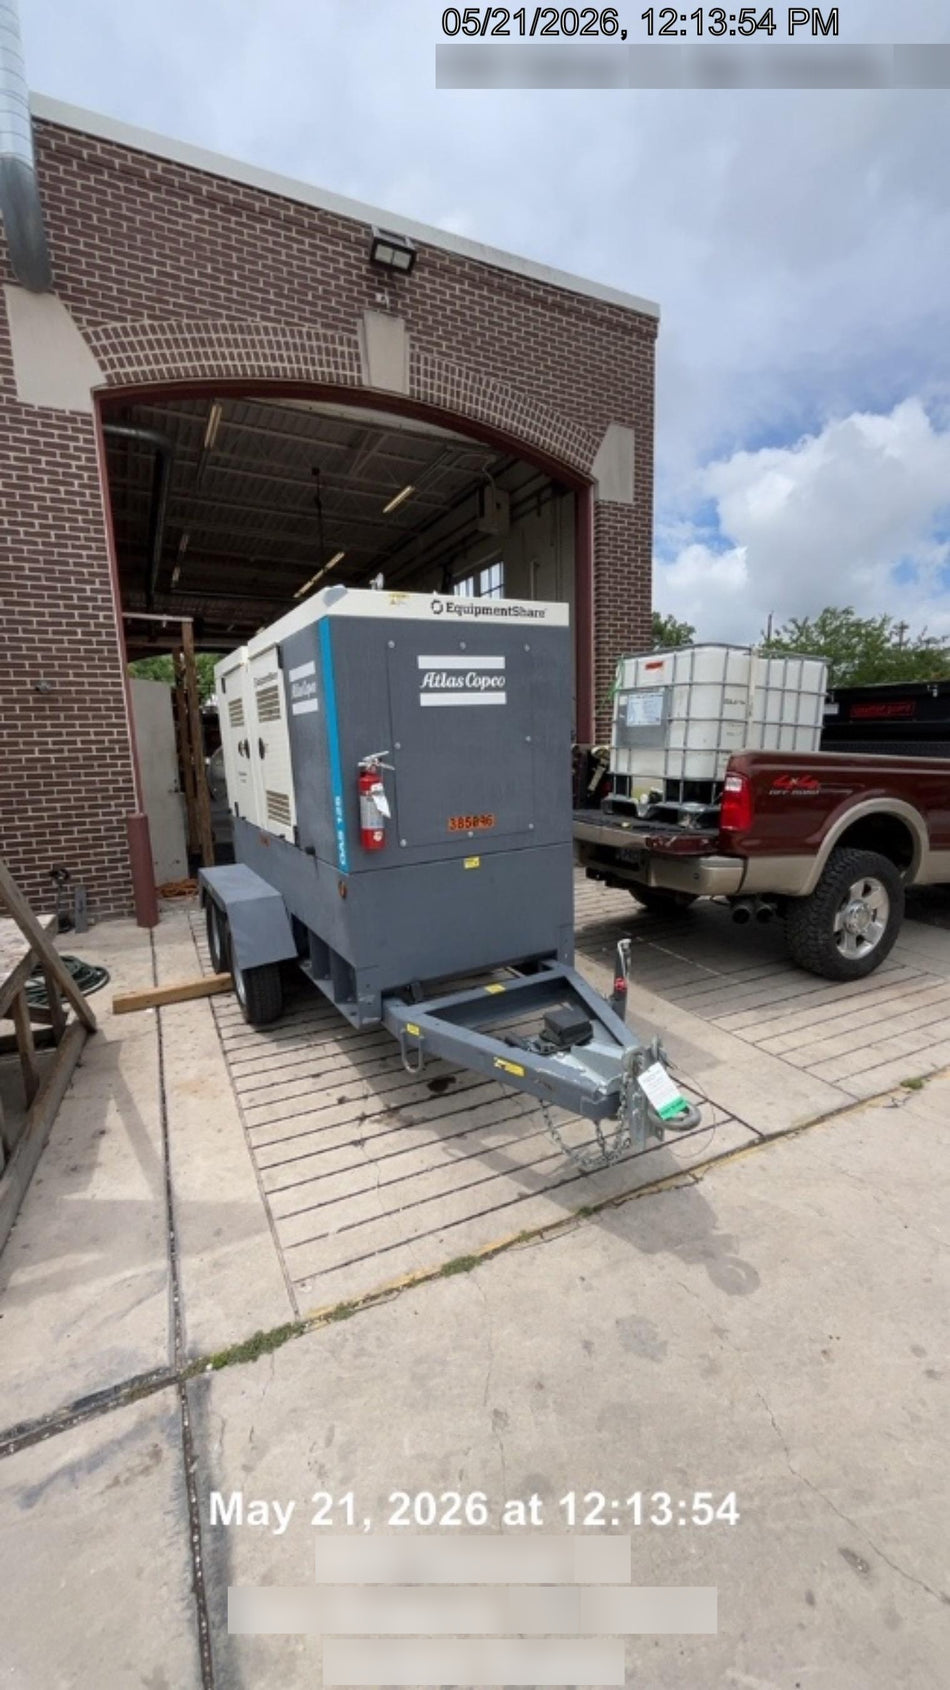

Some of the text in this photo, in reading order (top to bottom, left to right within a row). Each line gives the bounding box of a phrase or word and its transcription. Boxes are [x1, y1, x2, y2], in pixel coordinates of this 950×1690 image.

[446, 602, 546, 618] EquipmentShare
[420, 671, 506, 690] Atlas Copco
